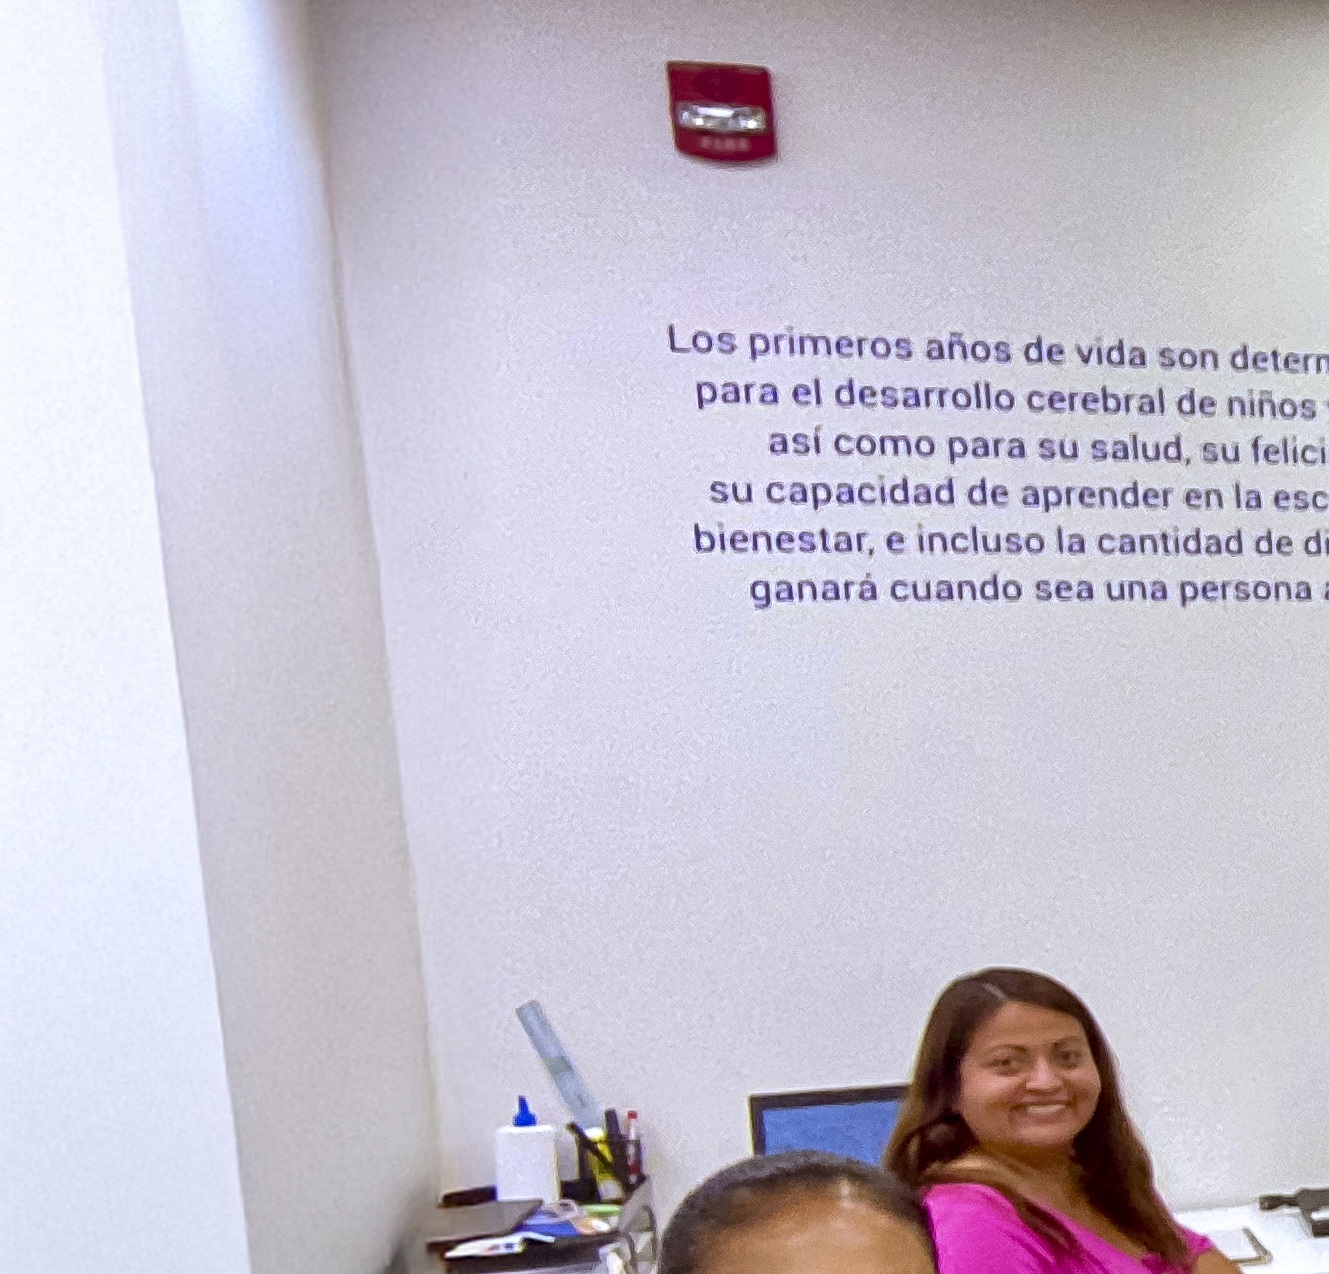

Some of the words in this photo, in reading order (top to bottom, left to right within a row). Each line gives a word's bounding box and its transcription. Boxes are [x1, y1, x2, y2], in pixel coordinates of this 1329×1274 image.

[667, 323, 738, 355] Los
[749, 325, 913, 362] primeros
[926, 331, 1012, 363] años
[1024, 335, 1065, 365] de
[1075, 336, 1146, 368] vida
[1158, 346, 1219, 371] son
[696, 380, 779, 411] para
[792, 377, 822, 408] el
[835, 378, 1015, 411] desarrollo
[1026, 385, 1165, 415] cerebral
[1176, 388, 1217, 417] de
[1227, 389, 1316, 421] niños
[769, 425, 821, 456] así
[834, 434, 935, 459] como
[948, 435, 1026, 466] para
[1039, 437, 1078, 461] su
[1091, 434, 1192, 466] salud,
[1202, 441, 1240, 465] su
[710, 480, 753, 505] su
[766, 475, 955, 511] capacidad
[967, 477, 1009, 507] de
[1022, 480, 1173, 513] aprender
[1183, 488, 1223, 511] en
[1235, 483, 1262, 510] la
[694, 523, 874, 557] bienestar,
[886, 531, 905, 555] e
[917, 524, 1045, 554] incluso
[1057, 526, 1085, 555] la
[1098, 527, 1243, 557] cantidad
[1255, 528, 1293, 556] de
[750, 573, 877, 610] ganará
[890, 572, 1022, 602] cuando
[1035, 579, 1094, 602] sea
[1106, 579, 1168, 602] una
[1180, 579, 1312, 608] persona
